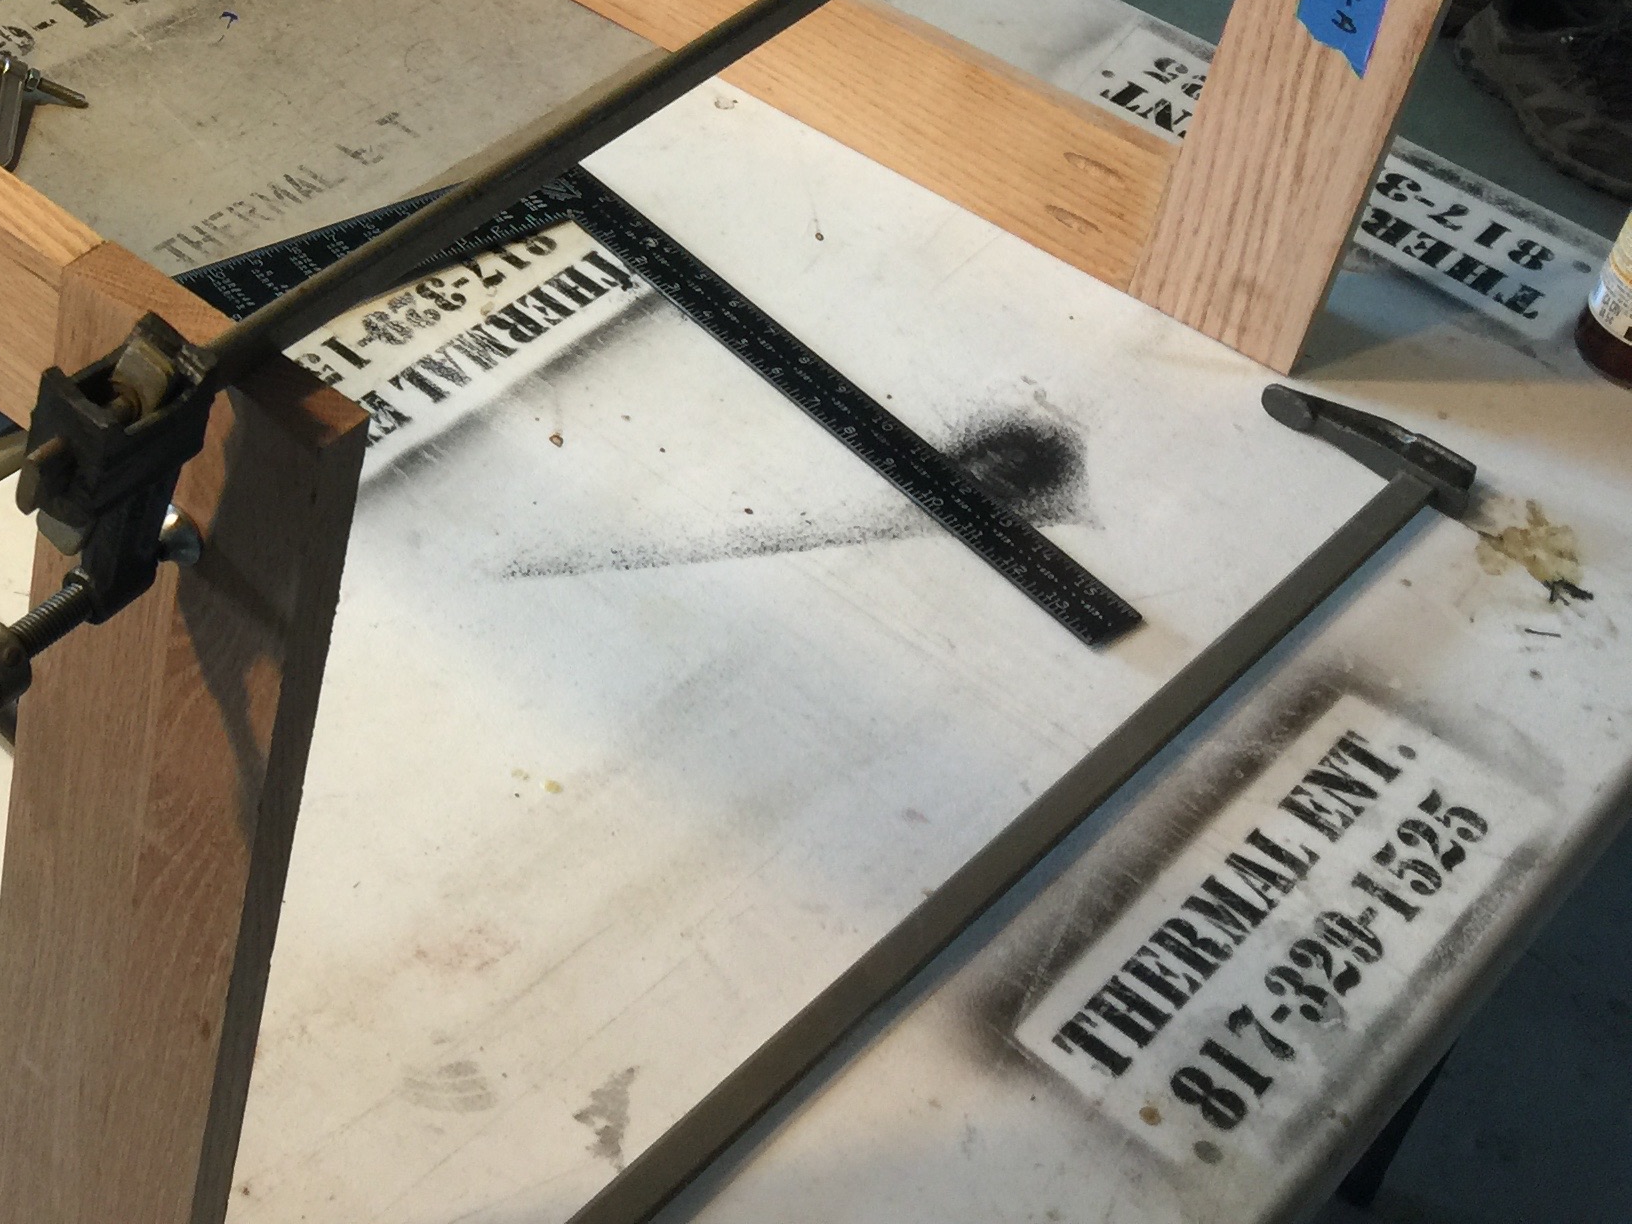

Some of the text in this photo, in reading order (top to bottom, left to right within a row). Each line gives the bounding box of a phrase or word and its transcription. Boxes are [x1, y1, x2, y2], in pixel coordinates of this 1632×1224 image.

[1099, 69, 1545, 321] THER NT.
[1376, 171, 1556, 275] 817-3
[394, 250, 634, 404] THERMAL
[1051, 730, 1418, 1077] THERMAL ENT.
